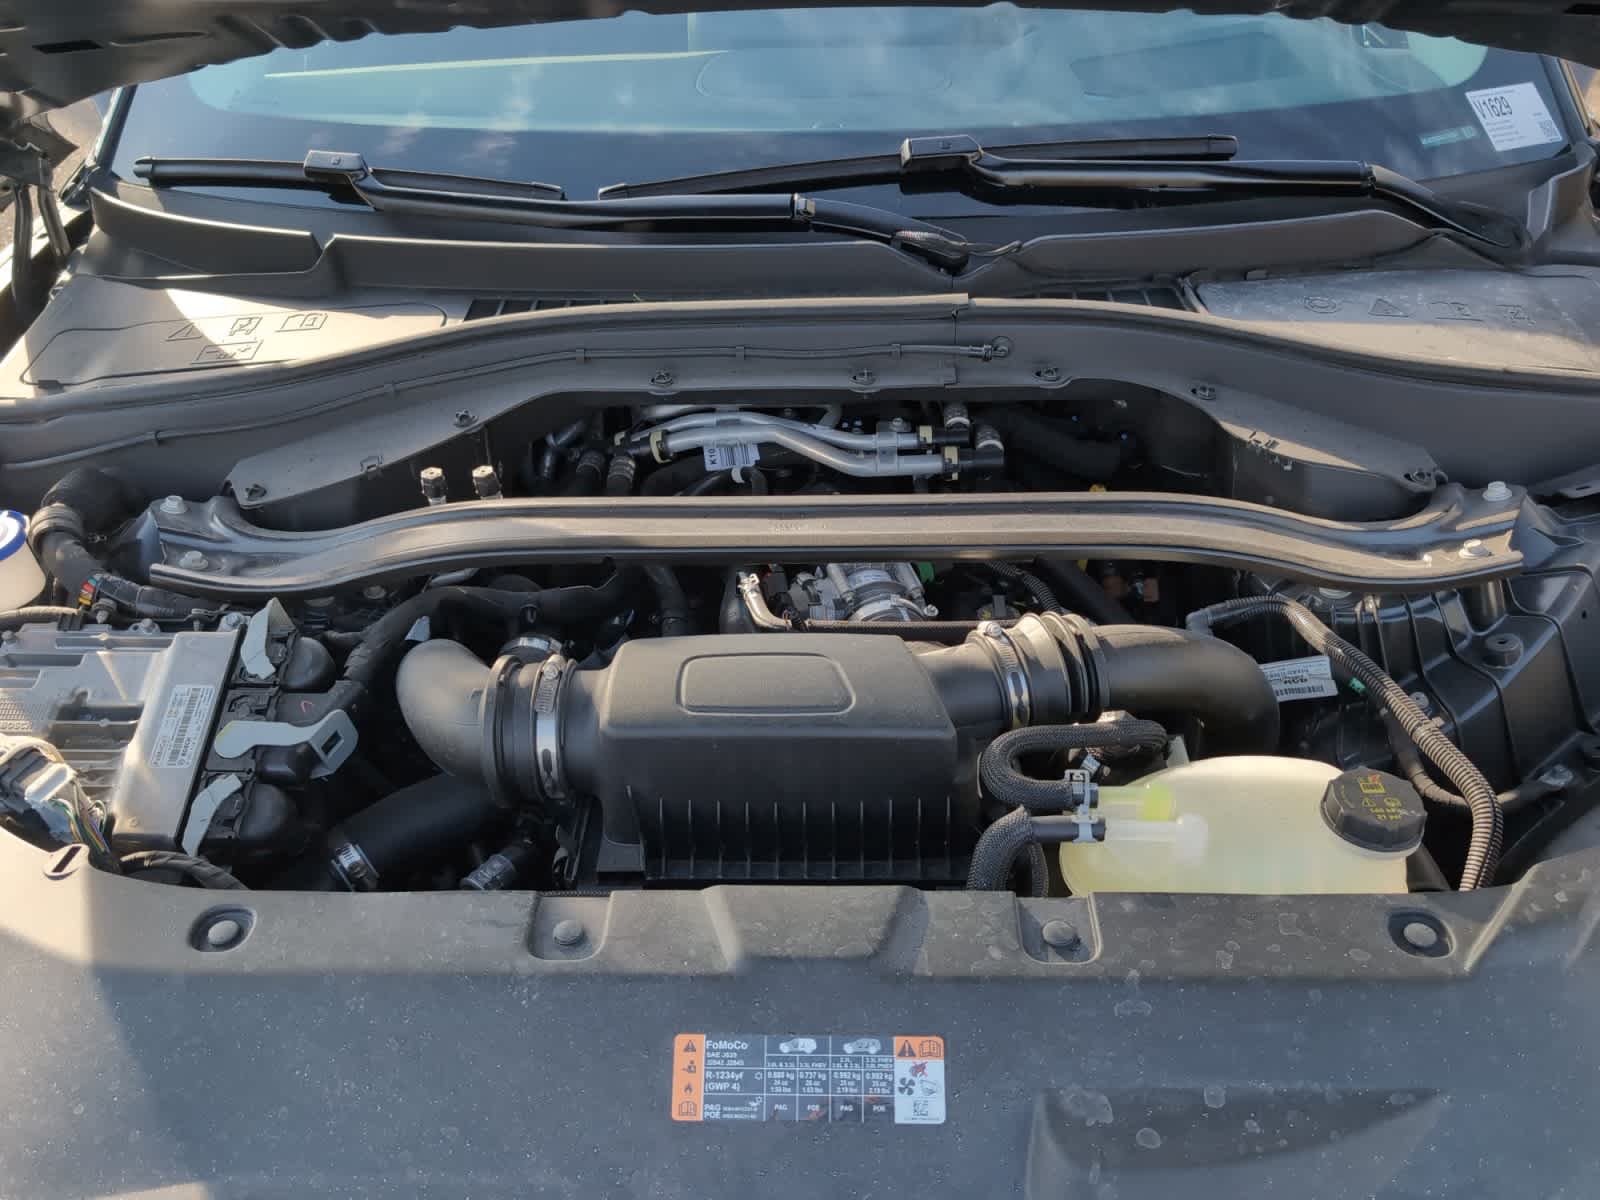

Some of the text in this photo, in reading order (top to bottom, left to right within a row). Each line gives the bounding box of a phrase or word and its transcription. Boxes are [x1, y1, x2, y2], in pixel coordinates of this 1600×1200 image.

[1473, 95, 1513, 119] V1629
[705, 1040, 748, 1050] FoMoCo
[705, 1071, 744, 1080] R-1234yf
[705, 1082, 741, 1092] (GWP 4)
[774, 1103, 788, 1111] PAG
[704, 1111, 721, 1119] POE
